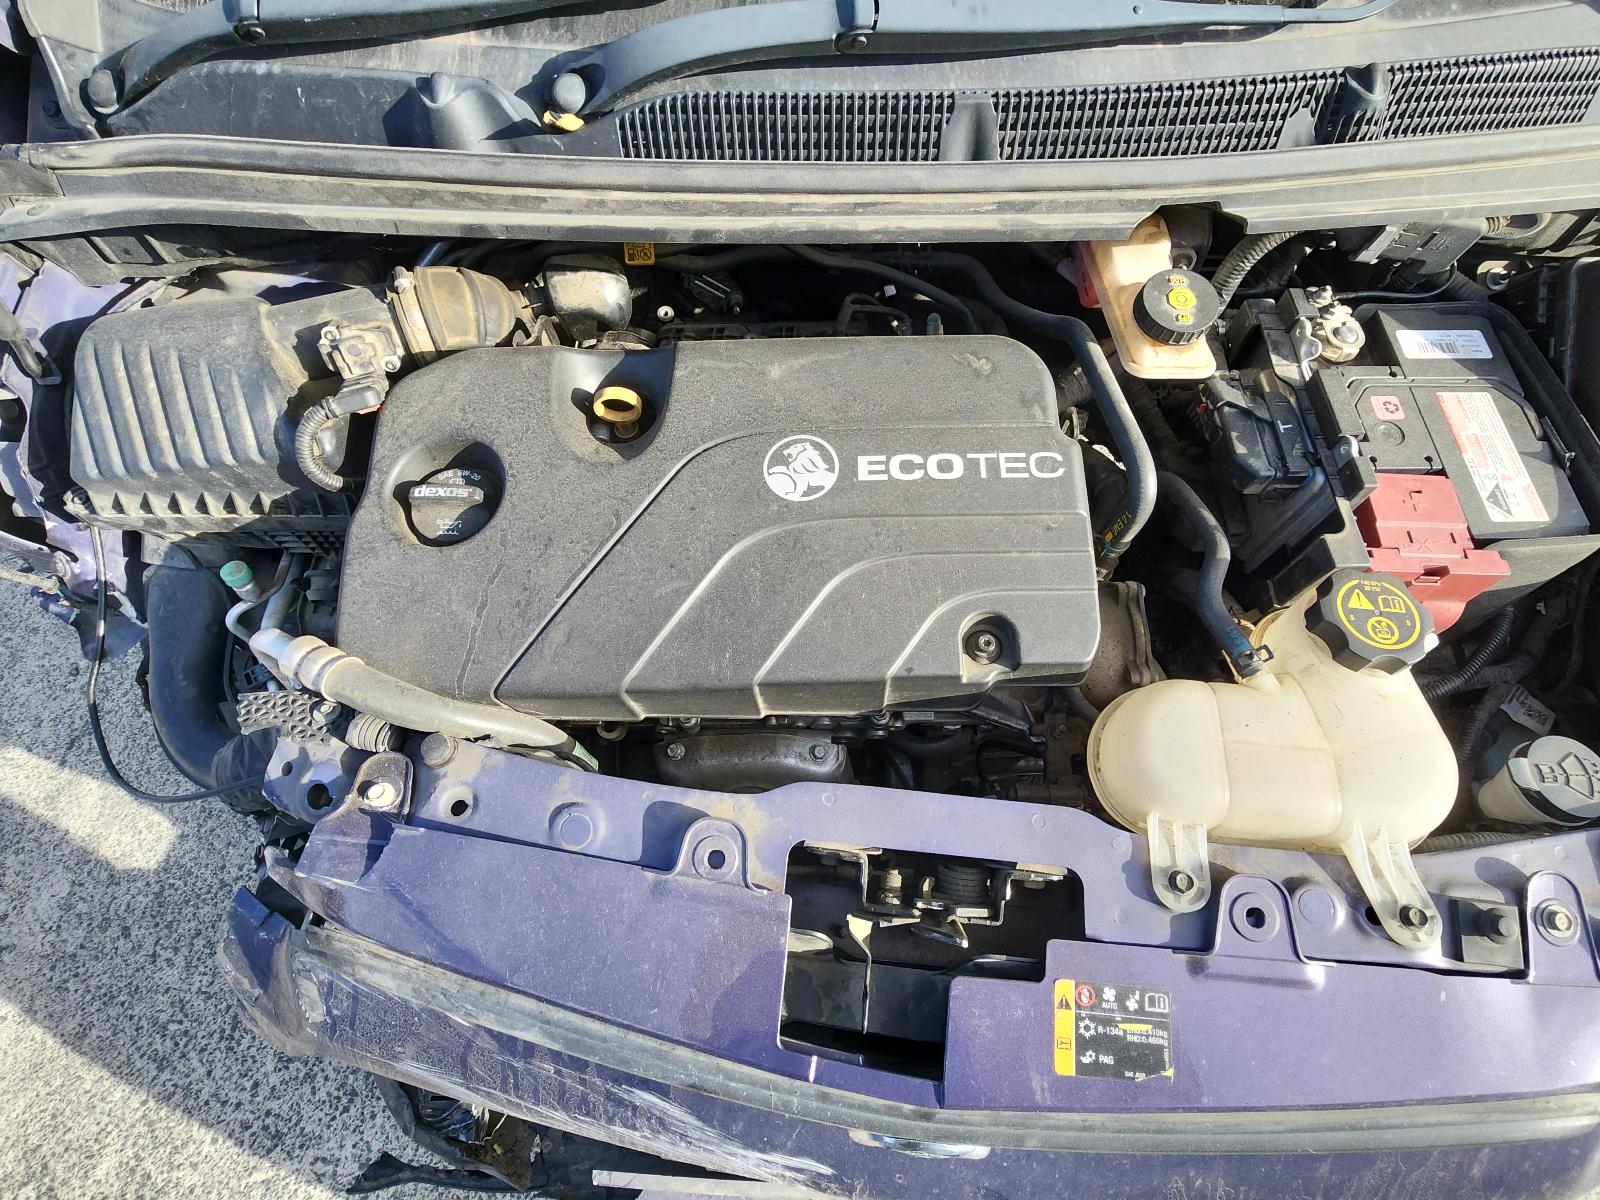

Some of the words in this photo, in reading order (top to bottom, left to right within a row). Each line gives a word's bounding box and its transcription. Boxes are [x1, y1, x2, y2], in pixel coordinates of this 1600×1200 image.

[857, 451, 1066, 481] ECOTEC
[438, 470, 454, 480] SAE
[414, 484, 469, 497] dexos
[1102, 1001, 1118, 1009] AUTO
[1097, 1025, 1124, 1036] R-134a
[1099, 1054, 1114, 1065] PAG
